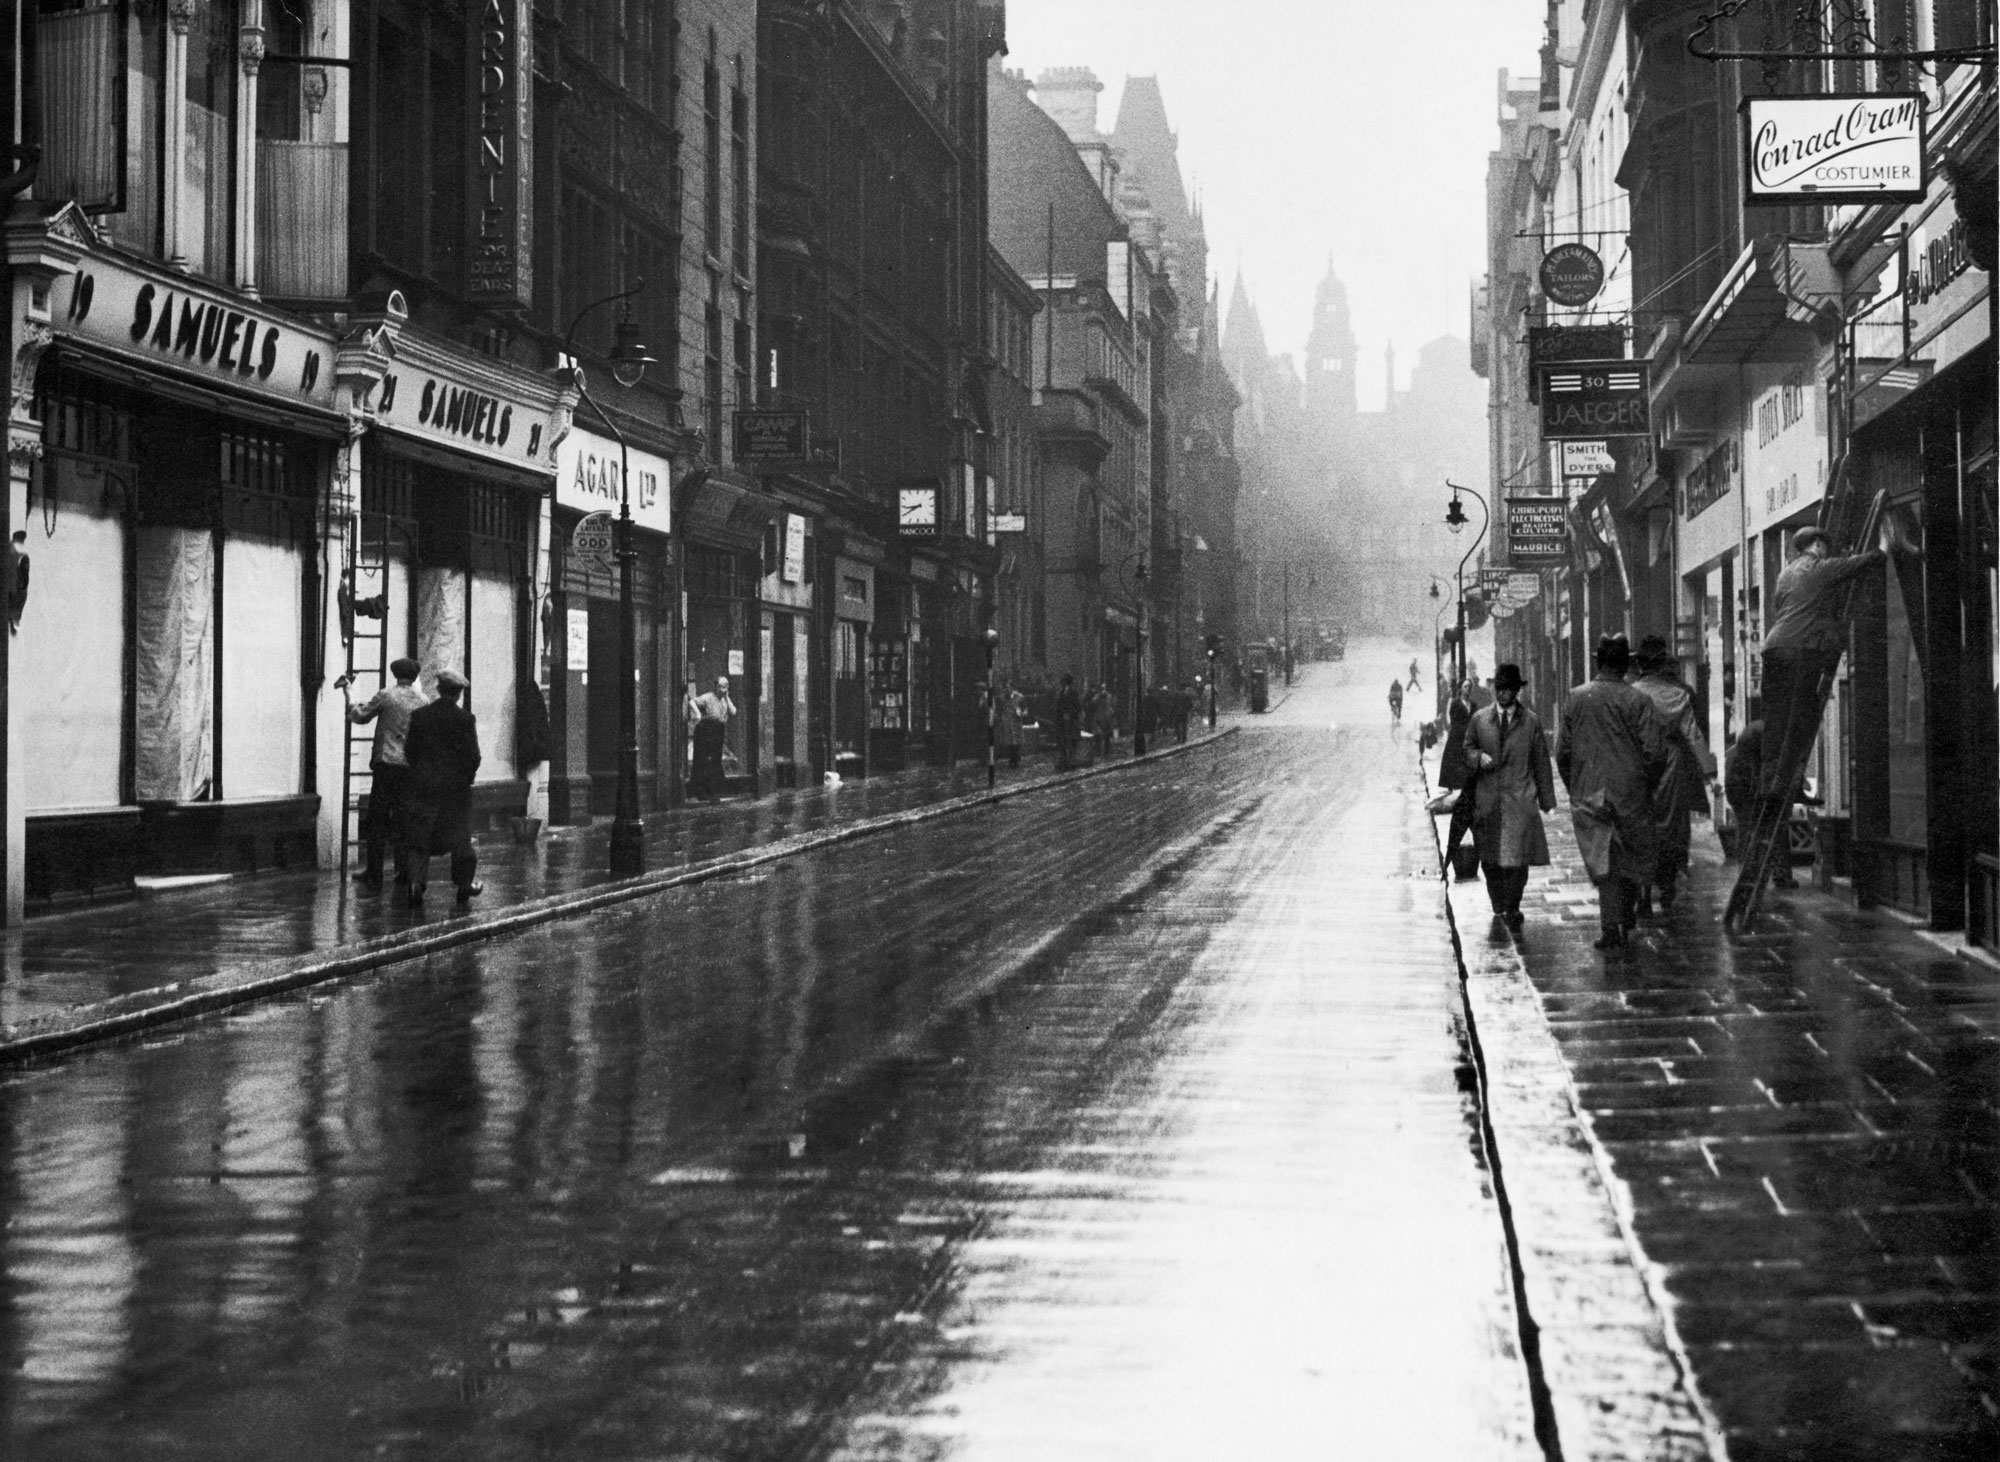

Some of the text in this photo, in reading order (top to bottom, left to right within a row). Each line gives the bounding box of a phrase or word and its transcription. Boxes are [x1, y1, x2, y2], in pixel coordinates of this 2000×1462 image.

[1753, 117, 1843, 187] Conrad
[1551, 274, 1594, 282] TAILORS
[68, 270, 319, 393] 19 SAMUELS 19
[1585, 377, 1604, 388] 30
[418, 379, 512, 447] SAMUELS
[1549, 400, 1643, 425] JAEGER
[1567, 445, 1605, 454] SMITH
[1569, 464, 1612, 472] DYERS
[1512, 506, 1563, 514] CHIROPODY
[579, 538, 608, 548] ODD
[1513, 543, 1562, 551] MAURICE
[1750, 618, 1760, 643] TO
[1750, 654, 1761, 690] LET
